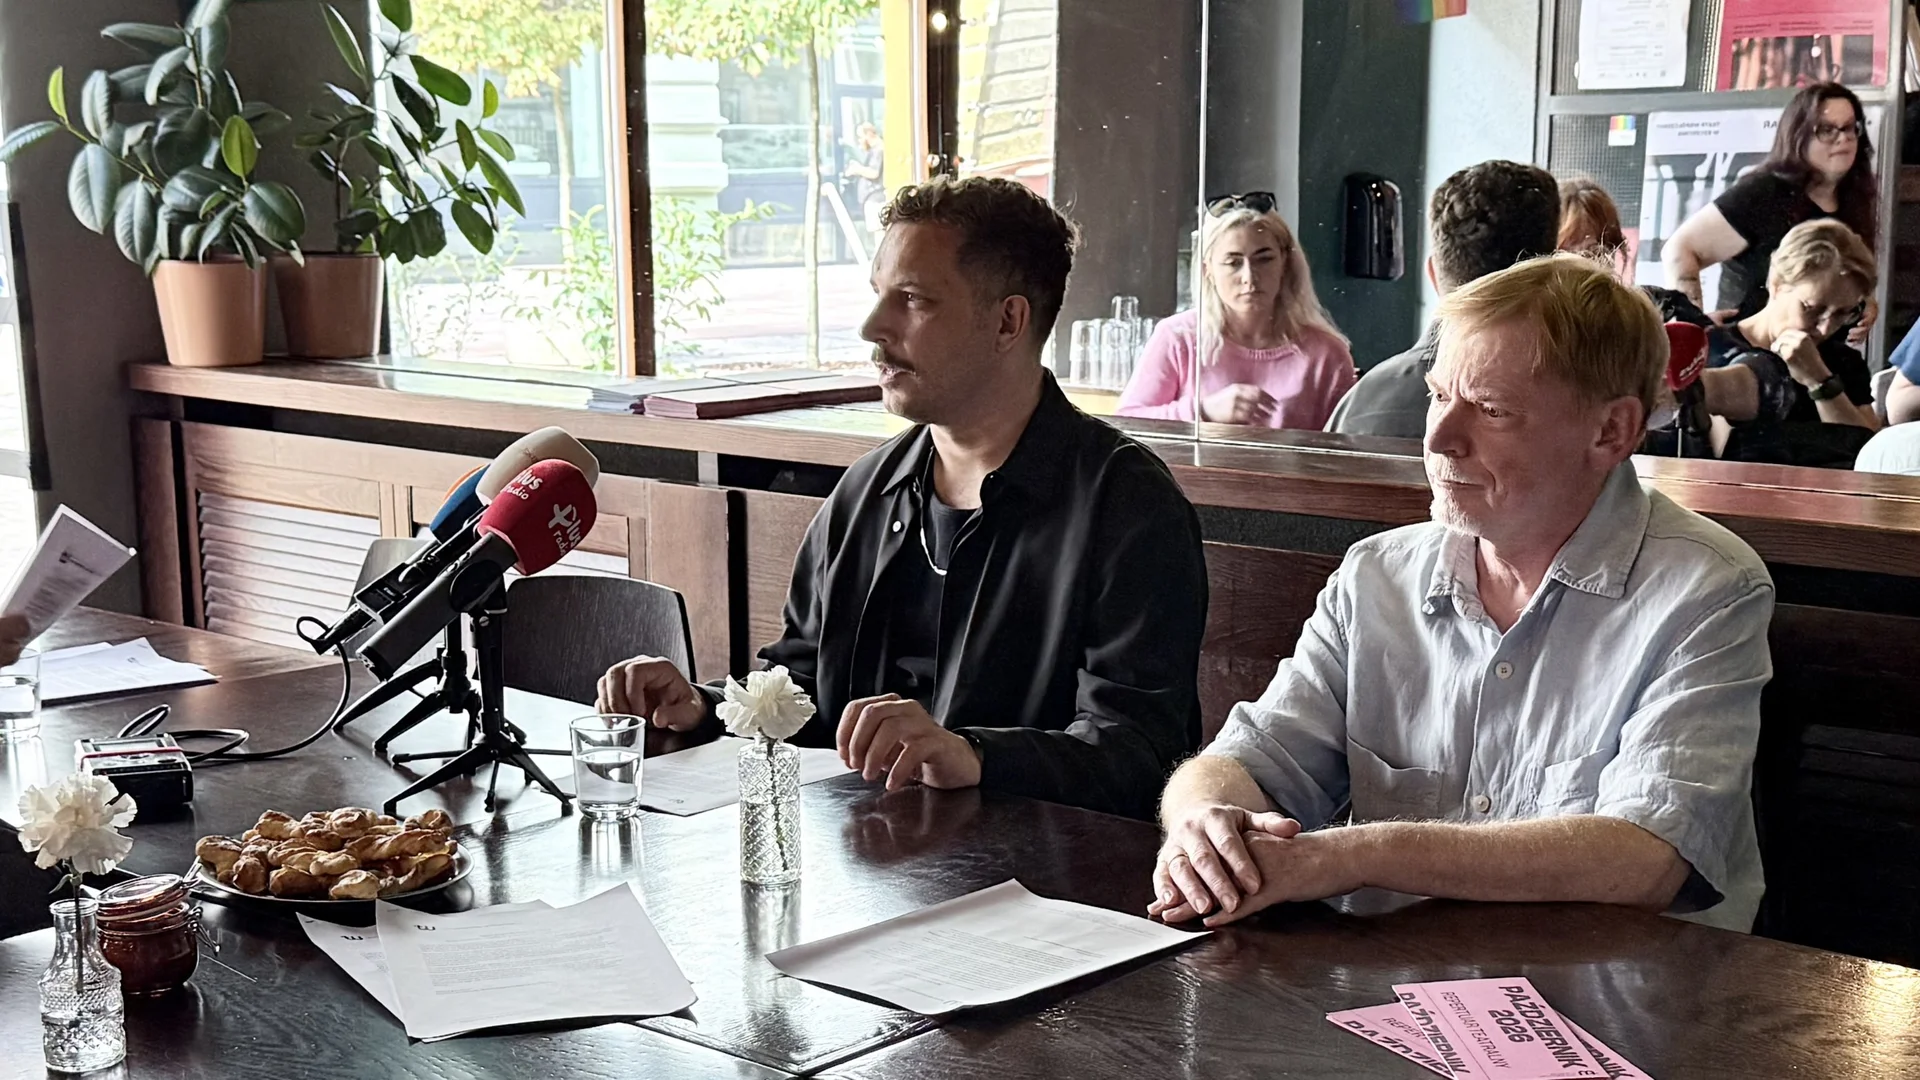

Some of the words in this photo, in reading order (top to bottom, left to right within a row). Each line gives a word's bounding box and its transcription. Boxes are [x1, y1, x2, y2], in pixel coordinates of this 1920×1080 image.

[1440, 991, 1480, 1029] REPERTUAR
[1469, 1028, 1512, 1069] TEATRALNY
[1487, 1009, 1535, 1043] 2026
[1498, 985, 1588, 1069] PAŹDZIERNIK
